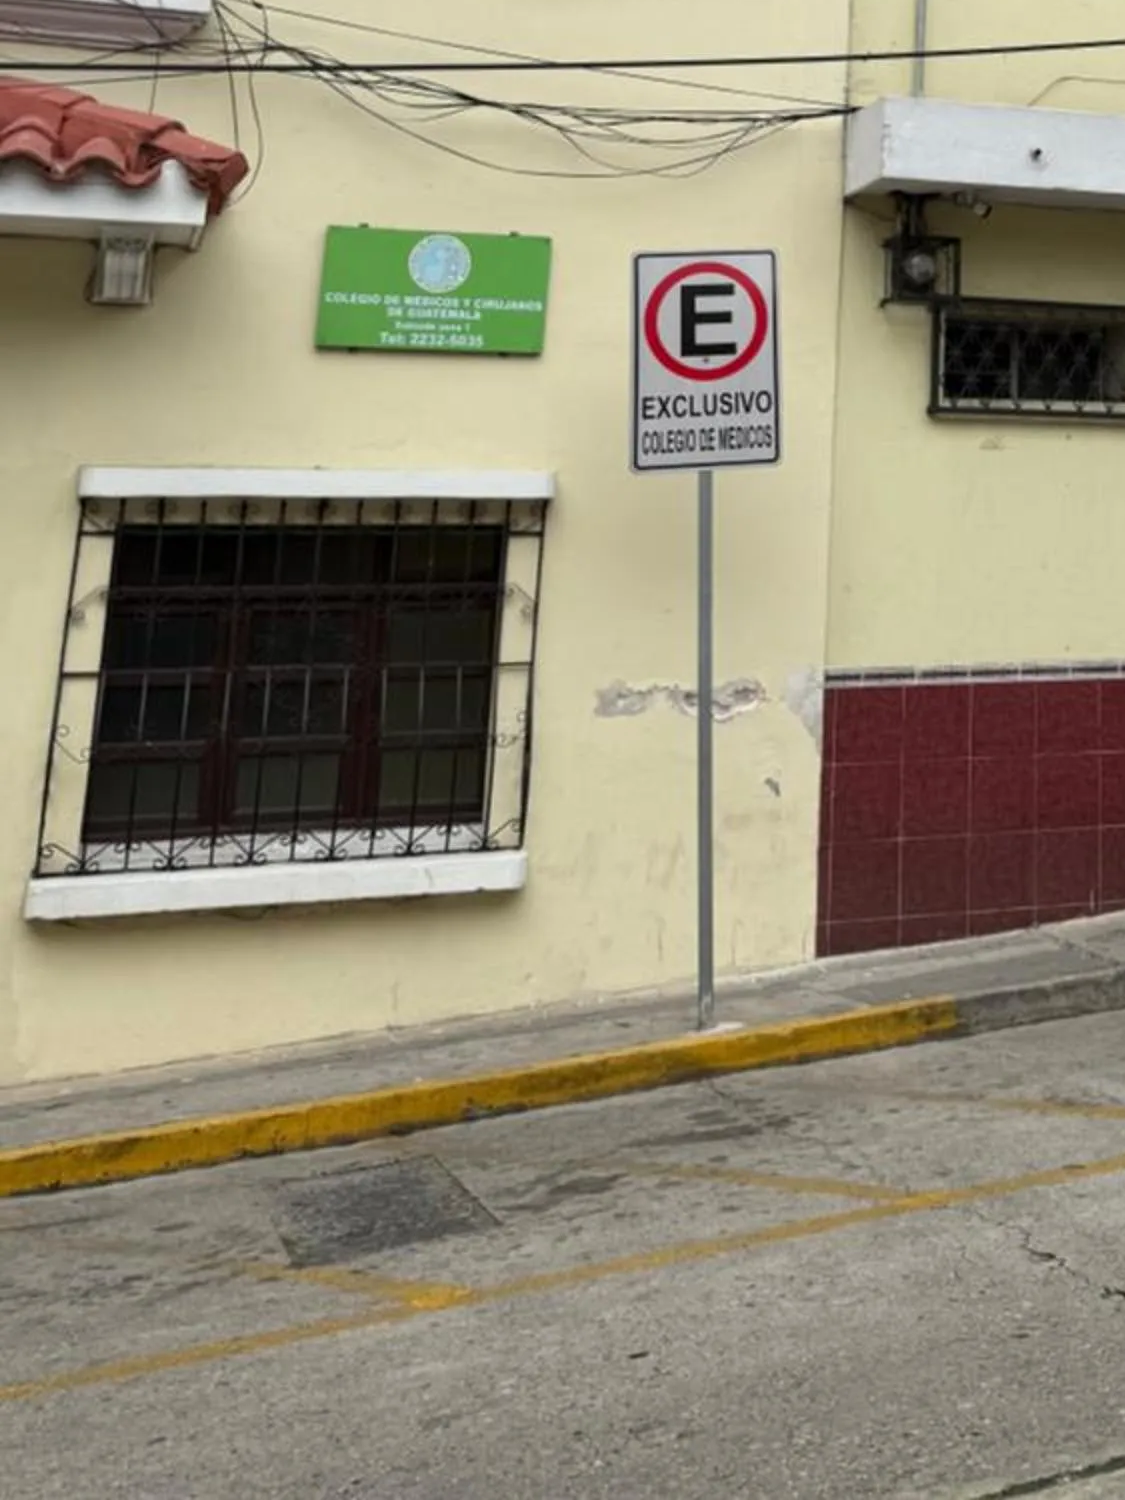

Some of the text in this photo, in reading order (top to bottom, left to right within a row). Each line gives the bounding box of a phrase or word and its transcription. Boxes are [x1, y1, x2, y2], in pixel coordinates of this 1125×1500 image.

[383, 294, 399, 305] DE
[387, 306, 481, 320] DE GUATEMALA
[680, 283, 737, 357] E
[641, 390, 772, 421] EXCLUSIVO
[642, 424, 772, 455] COLEGIO DE MEDICOS
